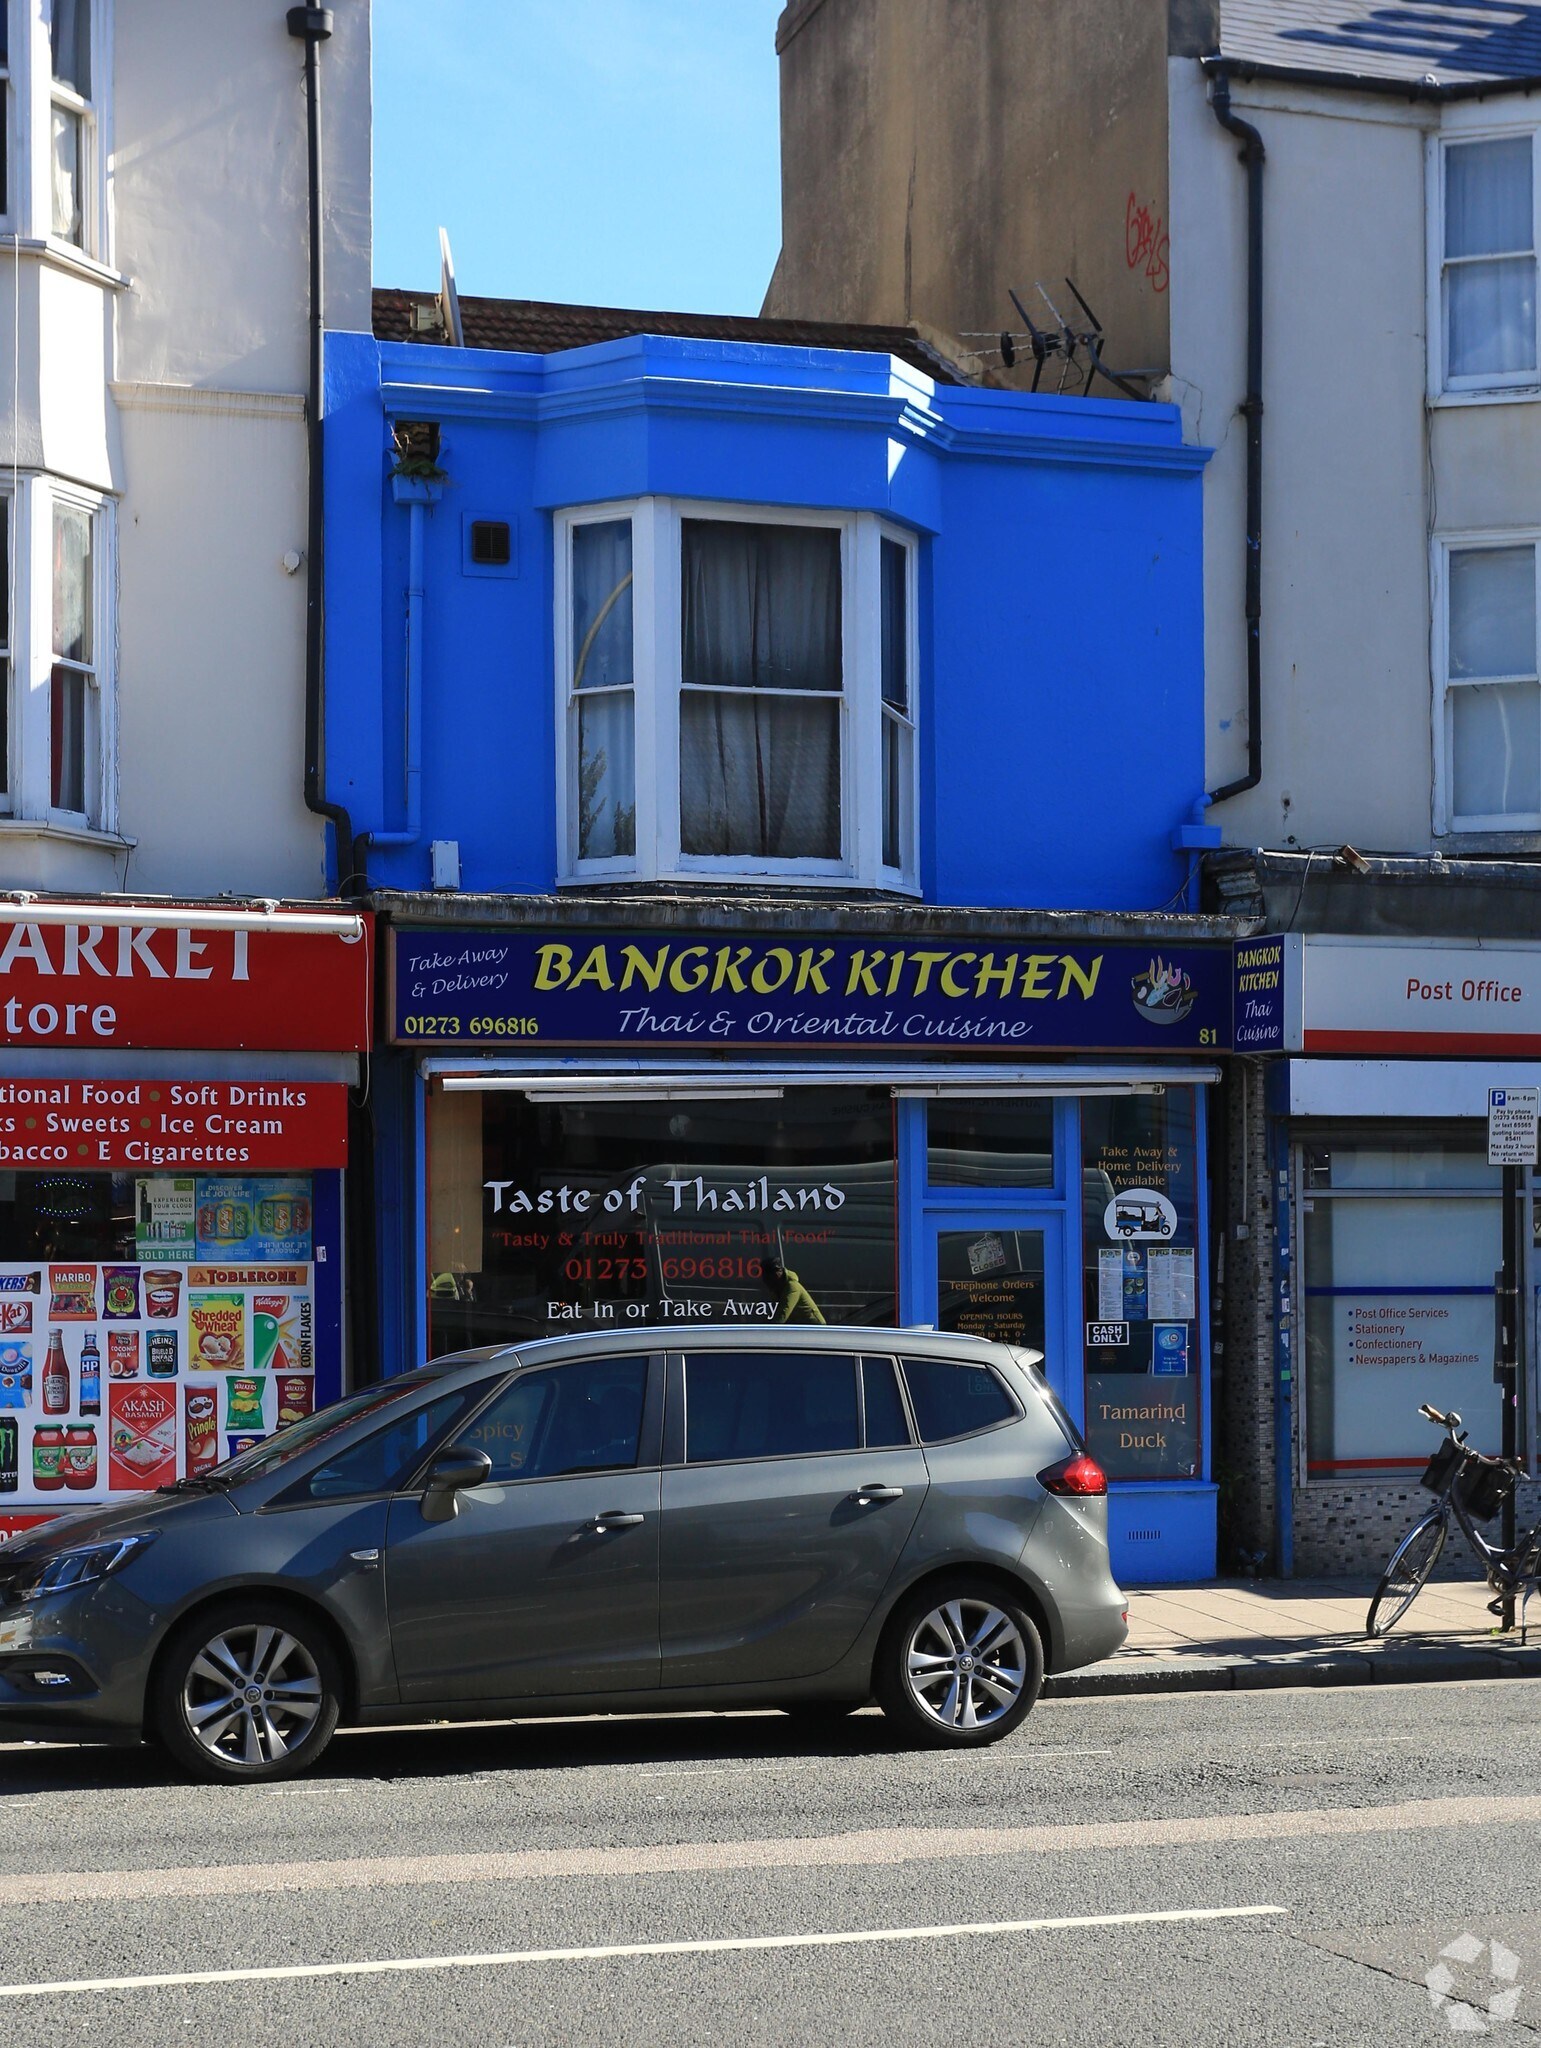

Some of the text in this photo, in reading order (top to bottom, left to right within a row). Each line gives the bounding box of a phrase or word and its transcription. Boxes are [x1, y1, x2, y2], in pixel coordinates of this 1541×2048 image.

[409, 946, 508, 973] Take Away
[1237, 946, 1281, 969] BANGKOK
[534, 944, 1103, 1000] BANGKOK KITCHEN
[411, 971, 508, 998] & Delivery
[1239, 970, 1279, 992] KITCHEN
[1406, 978, 1522, 1003] Post Office
[3, 995, 117, 1036] tore
[1245, 1000, 1273, 1019] Thai
[404, 1016, 539, 1035] 01273 696816
[619, 1007, 1033, 1039] Thai & Oriental Cuisine
[1199, 1027, 1218, 1045] 81
[1236, 1024, 1281, 1042] Cuisine
[0, 1084, 307, 1106] tional Food Soft Drinks
[1495, 1092, 1504, 1105] P
[0, 1112, 283, 1134] s Sweets Ice Cream
[98, 1141, 111, 1161] E
[125, 1141, 249, 1164] Cigarettes
[1101, 1146, 1178, 1158] Take Away &
[1098, 1160, 1181, 1173] Home Delivery
[1114, 1175, 1165, 1186] Available
[482, 1175, 846, 1214] Taste of Thailand
[557, 1232, 574, 1246] &
[584, 1231, 628, 1249] Truly
[635, 1230, 732, 1246] Traditional
[738, 1229, 777, 1244] Thai
[138, 1250, 164, 1260] SOLD
[168, 1250, 194, 1260] HERE
[565, 1257, 764, 1281] 01273 696816
[973, 1258, 1004, 1273] CLOSED
[55, 1273, 91, 1283] HARIBO
[207, 1269, 297, 1284] TOBLERONE
[950, 1280, 1034, 1292] Telephone Orders
[969, 1293, 1015, 1303] Welcome
[191, 1308, 242, 1323] Shredded
[547, 1298, 779, 1320] Eat In or Take Away
[960, 1312, 1023, 1321] OPENING HOURS
[1355, 1307, 1449, 1319] Post Office Services
[301, 1302, 311, 1339] FLAKES
[957, 1322, 1026, 1331] Monday Saturday
[1355, 1323, 1405, 1335] Stationery
[1092, 1325, 1122, 1335] CASH
[1092, 1334, 1123, 1343] ONLY
[152, 1337, 173, 1345] HEINZ
[1355, 1339, 1423, 1350] Confectionery
[301, 1341, 311, 1368] CORN
[1356, 1353, 1480, 1367] Newspapers & Magazines
[81, 1360, 98, 1372] HP
[233, 1382, 257, 1391] WALKERS
[121, 1400, 165, 1412] AKASH
[1099, 1403, 1186, 1421] Tamarind
[187, 1416, 217, 1441] Pringles
[1119, 1432, 1166, 1449] Duck
